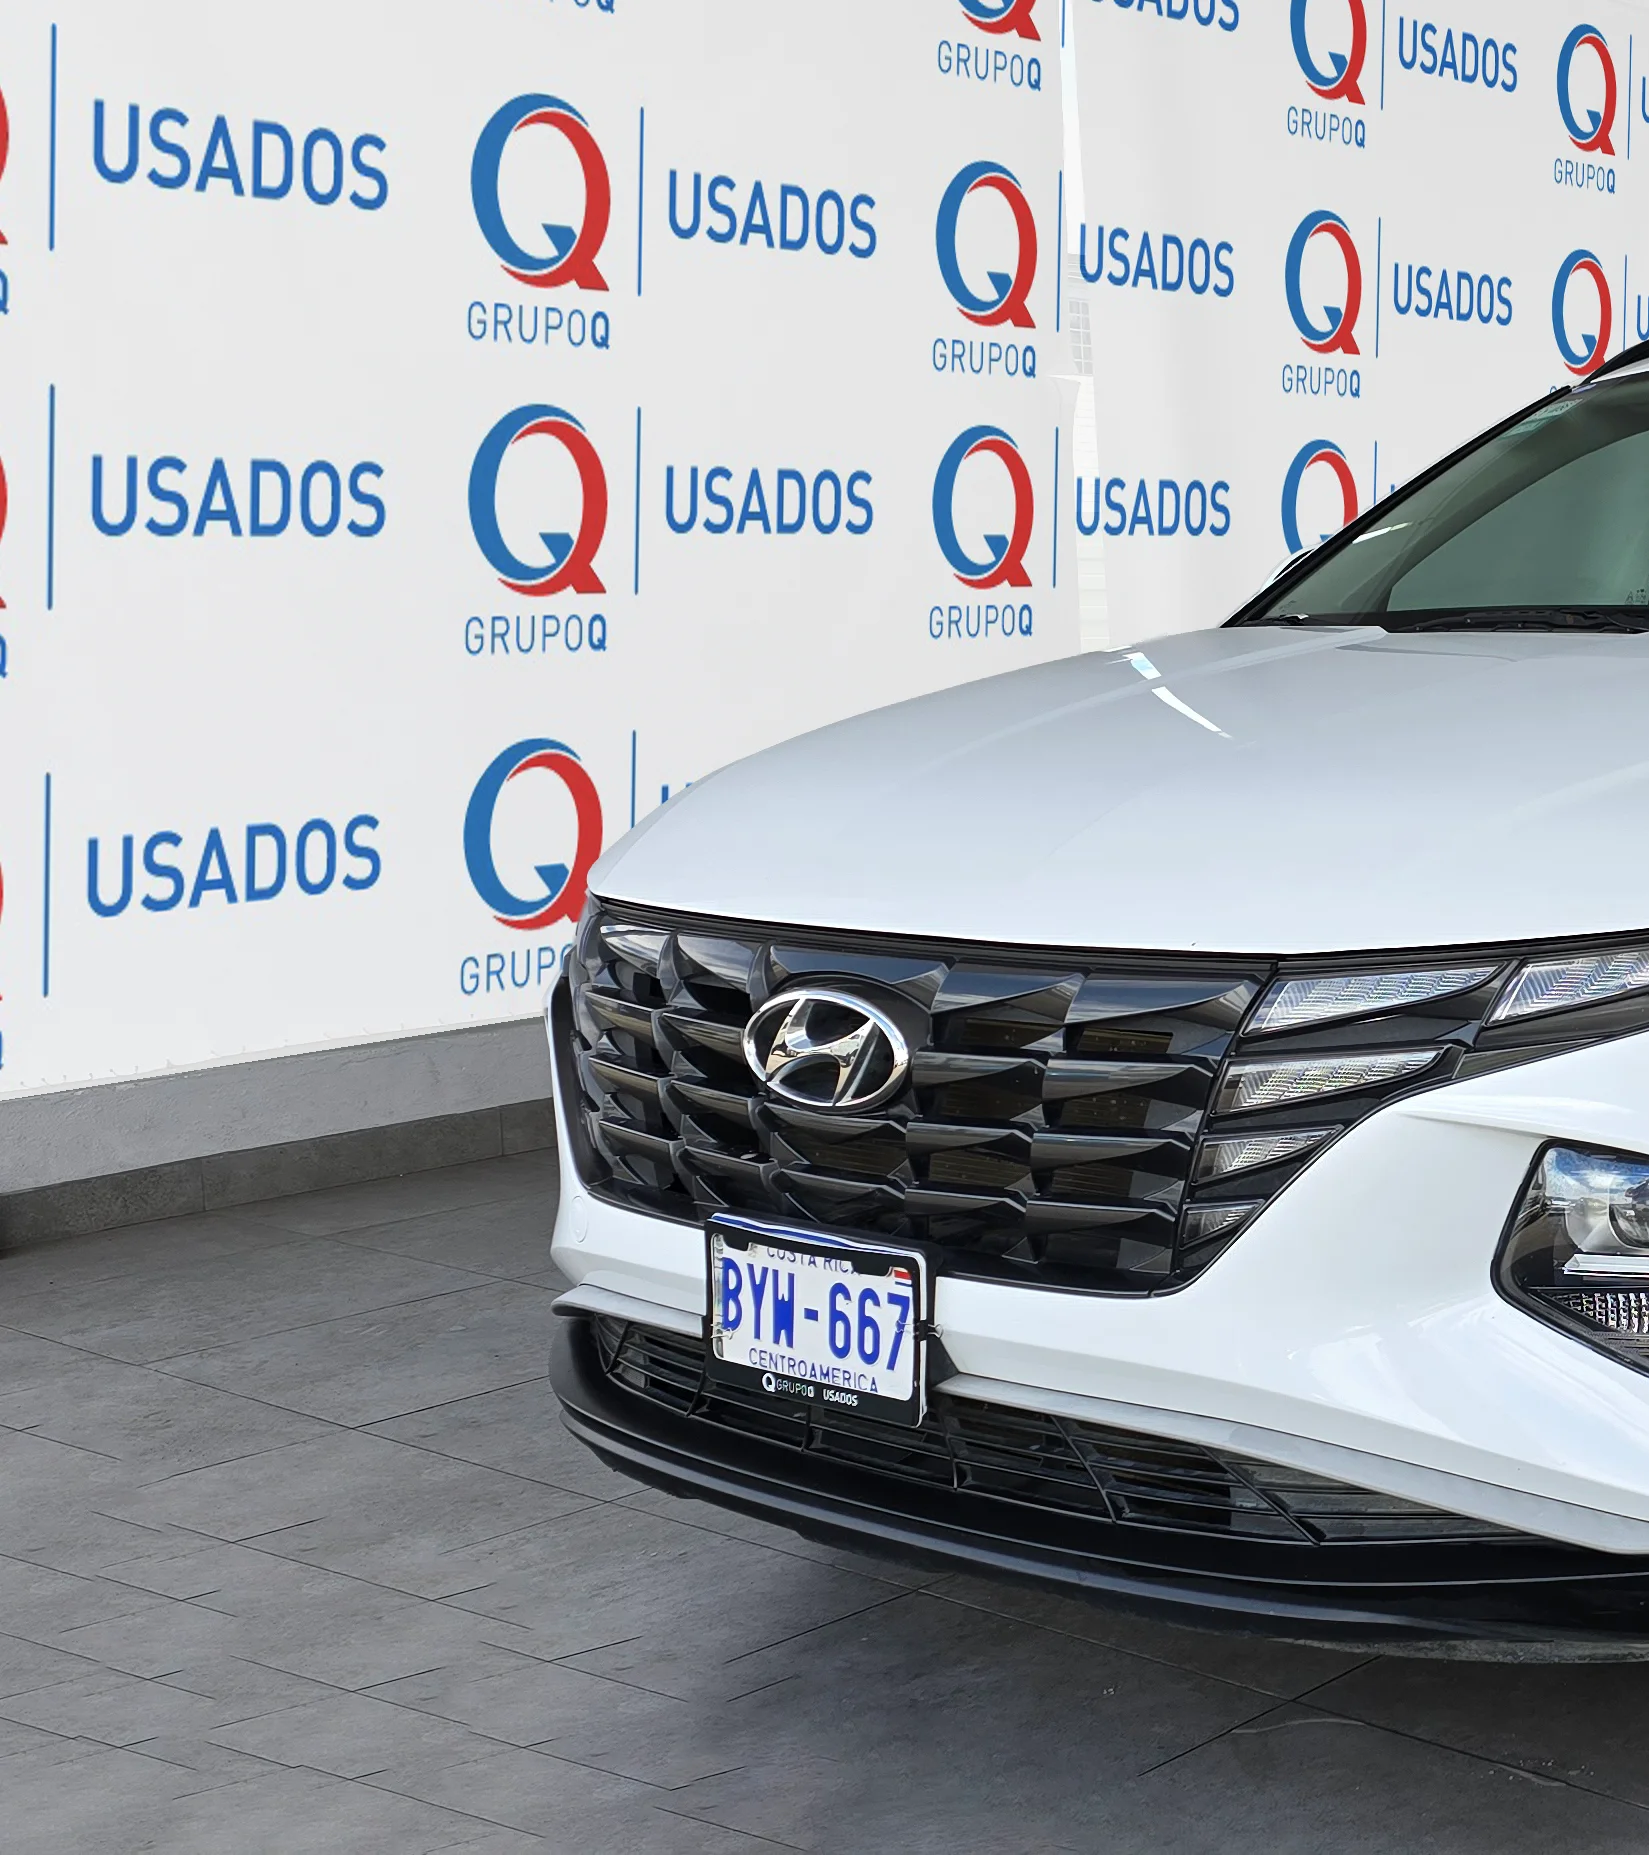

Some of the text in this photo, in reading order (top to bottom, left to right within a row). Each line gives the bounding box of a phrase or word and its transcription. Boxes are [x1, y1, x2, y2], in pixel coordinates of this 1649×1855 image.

[937, 39, 1043, 92] GRUPOQ
[1397, 15, 1518, 94] USADOS
[1287, 105, 1366, 149] GRUPOQ
[92, 97, 390, 212] USADOS
[1553, 157, 1616, 194] GRUPOQ
[668, 168, 878, 260] USADOS
[1079, 223, 1235, 299] USADOS
[1392, 261, 1513, 327] USADOS
[466, 300, 611, 351] GRUPOQ
[931, 337, 1037, 379] GRUPOQ
[1281, 363, 1361, 399] GRUPOQ
[89, 453, 387, 539] USADOS
[664, 464, 875, 536] USADOS
[1075, 476, 1232, 537] USADOS
[464, 612, 608, 657] GRUPOQ
[929, 603, 1033, 641] GRUPOQ
[85, 813, 383, 919] USADOS
[823, 1257, 860, 1275] RIC
[721, 1256, 911, 1372] BYW-667
[748, 1347, 879, 1394] CENTROAMERICA
[822, 1388, 859, 1407] USADOS
